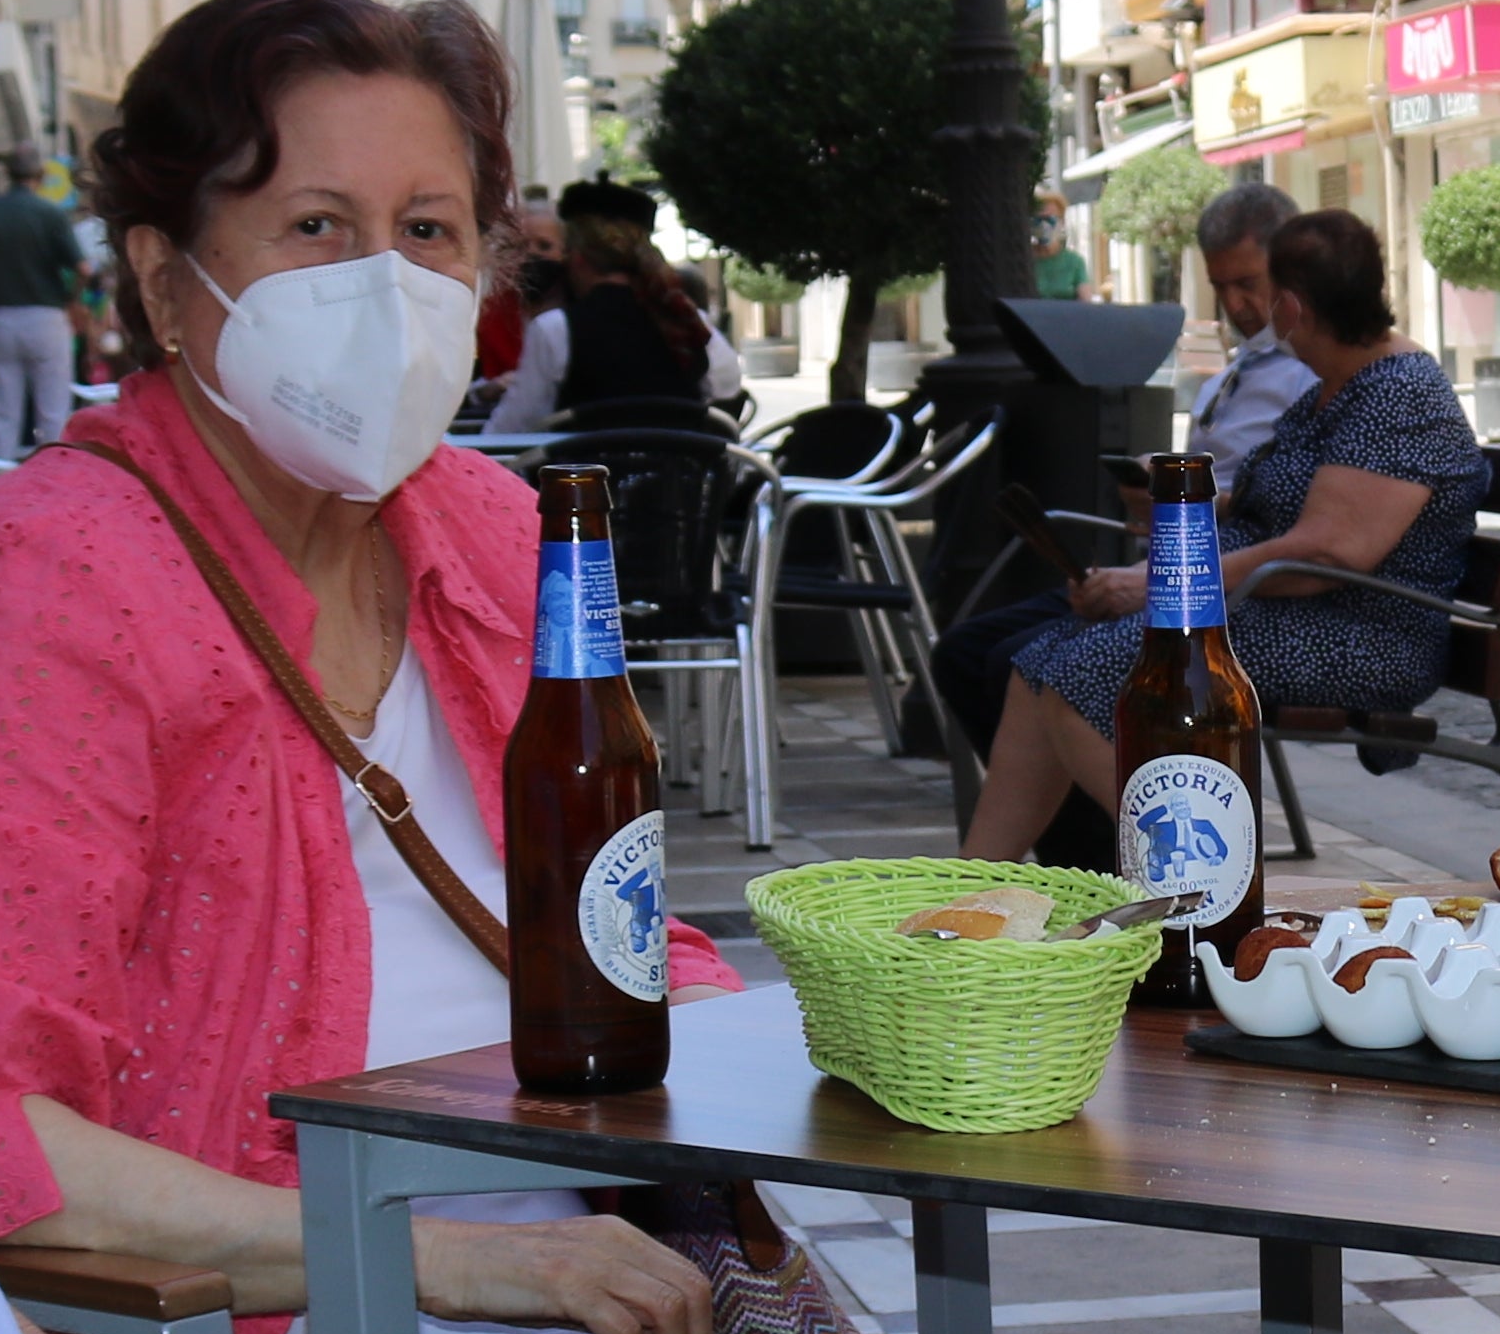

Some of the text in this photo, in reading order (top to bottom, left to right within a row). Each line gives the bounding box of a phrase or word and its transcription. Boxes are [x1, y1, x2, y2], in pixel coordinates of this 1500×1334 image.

[1152, 564, 1210, 575] VICTORIA
[1167, 576, 1191, 586] SIN
[1188, 762, 1240, 794] EXQUISITA
[1129, 772, 1234, 818] VICTORIA
[586, 889, 600, 945] CERVEZA
